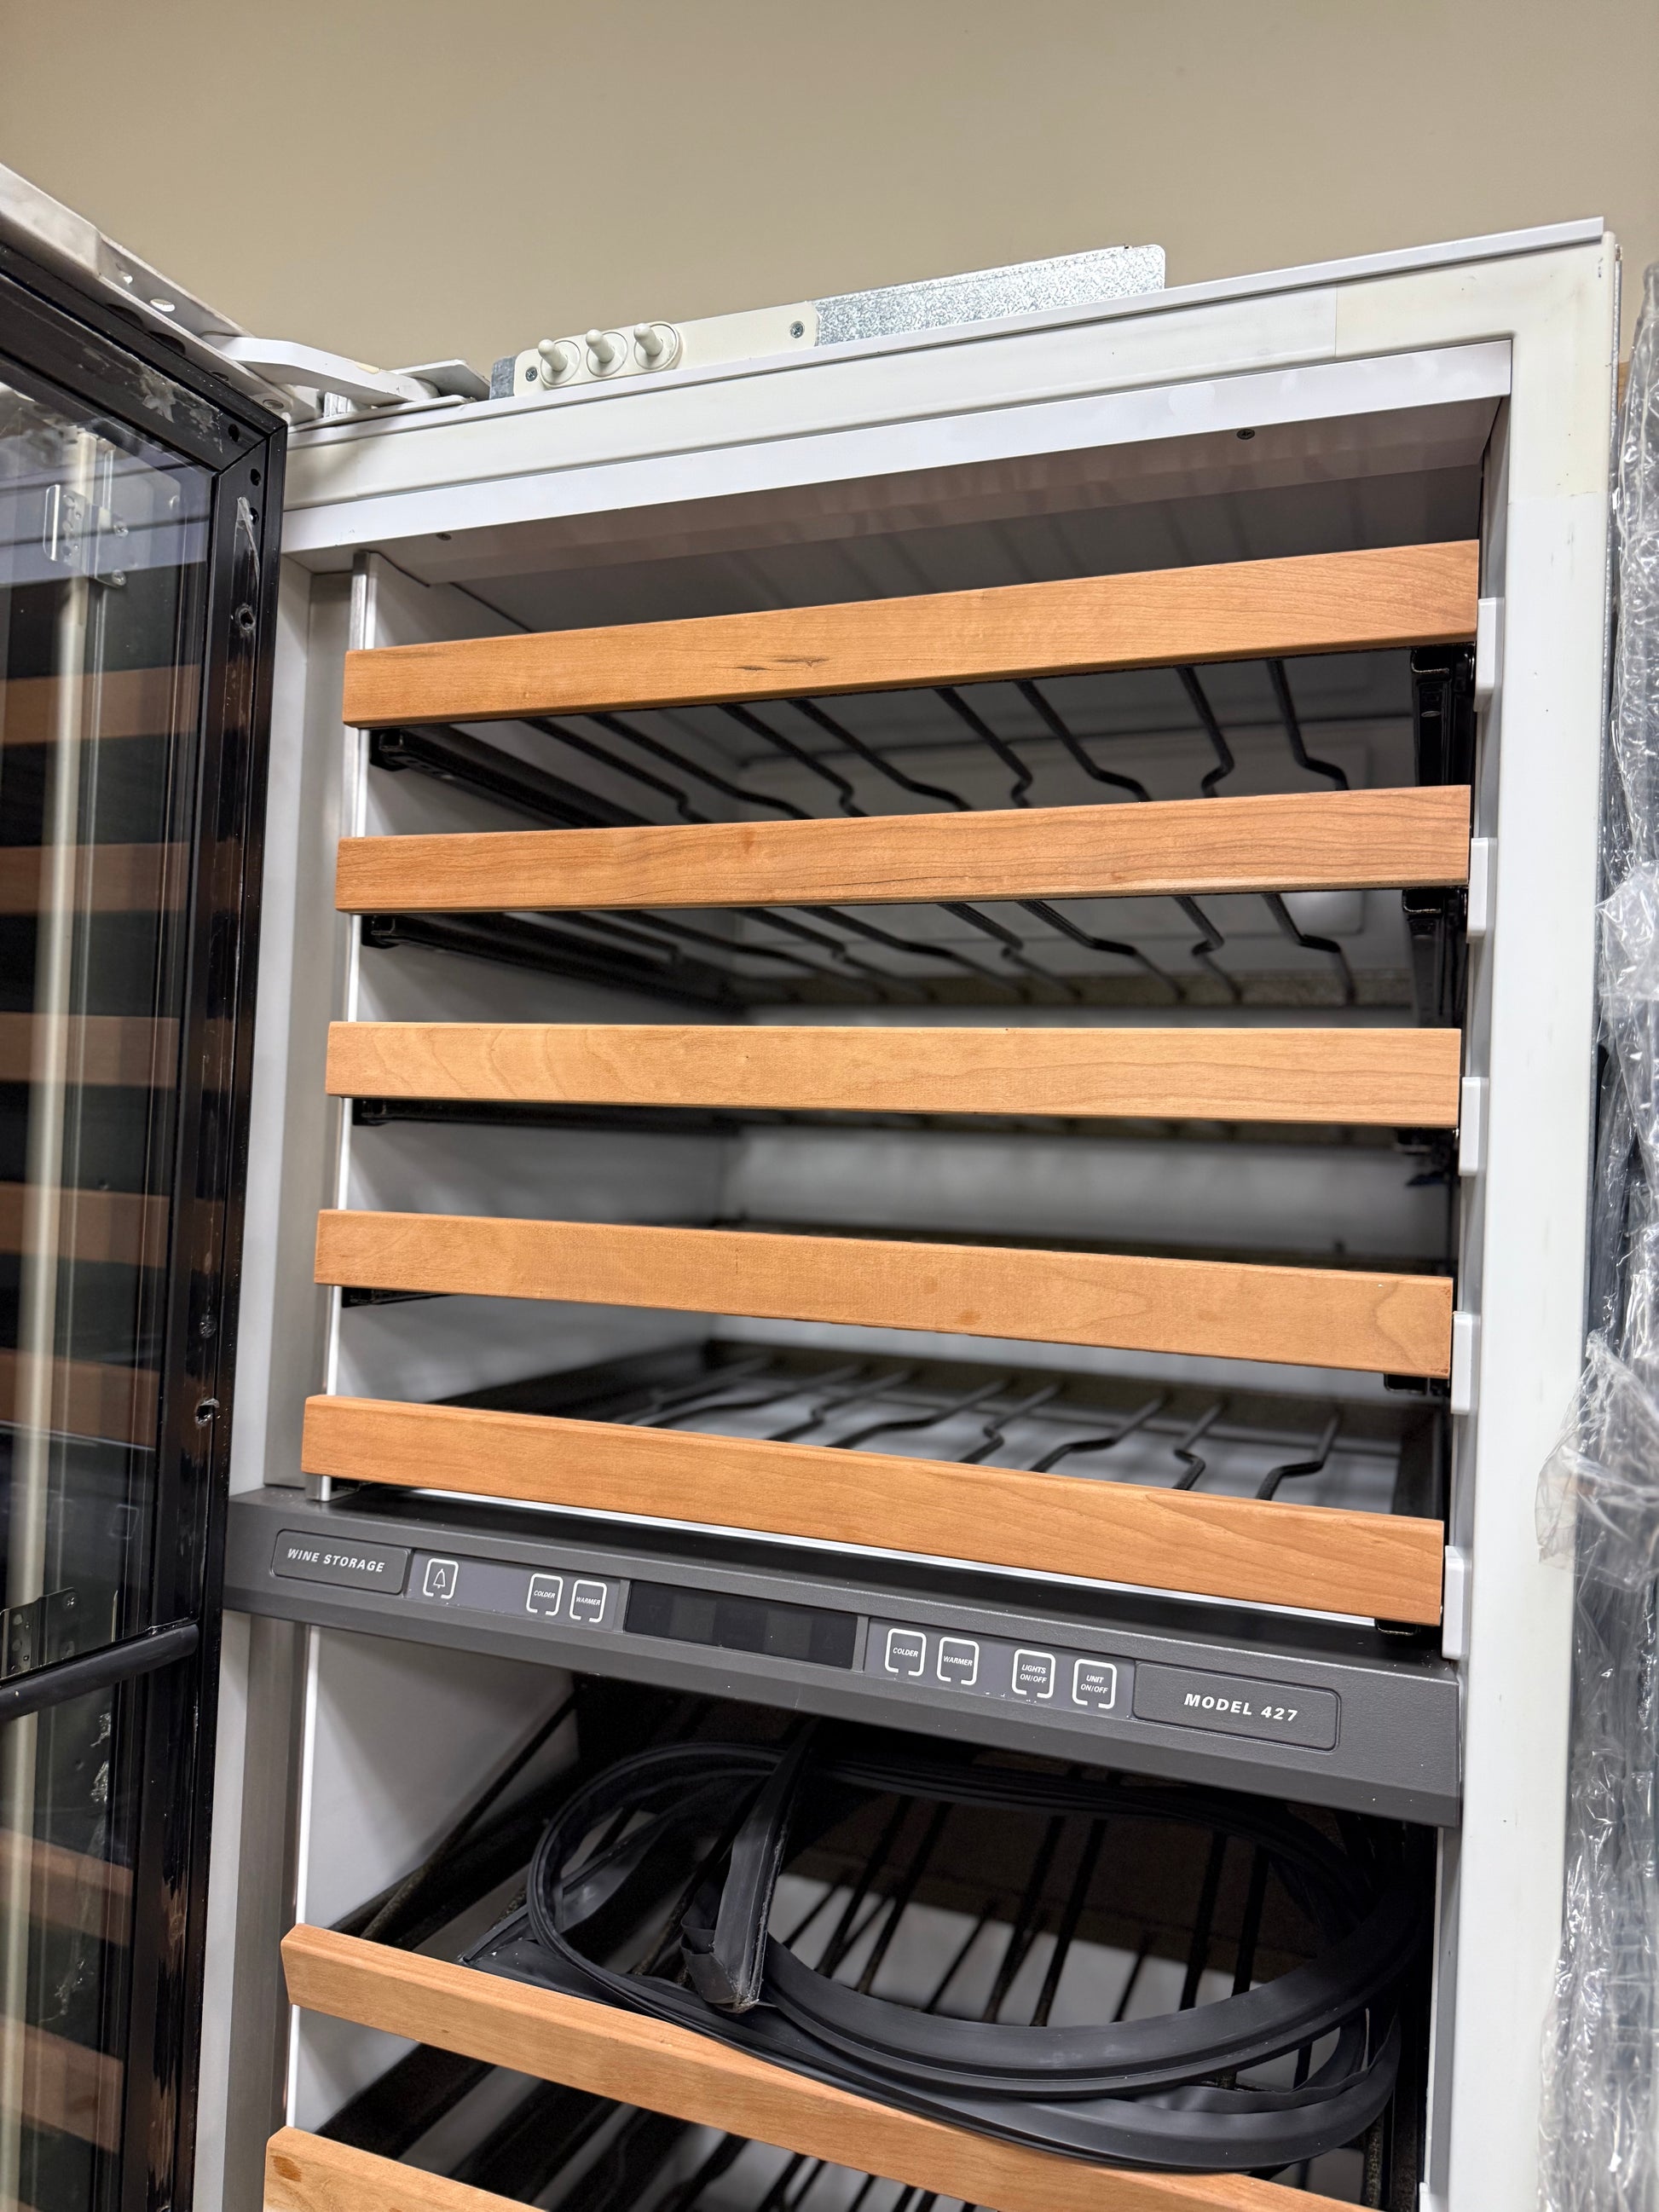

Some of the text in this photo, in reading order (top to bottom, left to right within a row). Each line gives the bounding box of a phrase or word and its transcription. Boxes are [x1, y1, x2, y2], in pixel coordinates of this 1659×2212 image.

[287, 1548, 385, 1573] WINE STORAGE
[534, 1590, 556, 1599] COLDER
[575, 1596, 601, 1606] WARMER
[893, 1647, 919, 1658] COLDER
[943, 1655, 973, 1666] WARMER
[1021, 1664, 1047, 1674] LIGHTS
[1020, 1673, 1048, 1684] ON/OFF
[1086, 1674, 1105, 1684] UNIT
[1080, 1684, 1108, 1694] ON/OFF
[1183, 1693, 1298, 1722] MODEL 427
